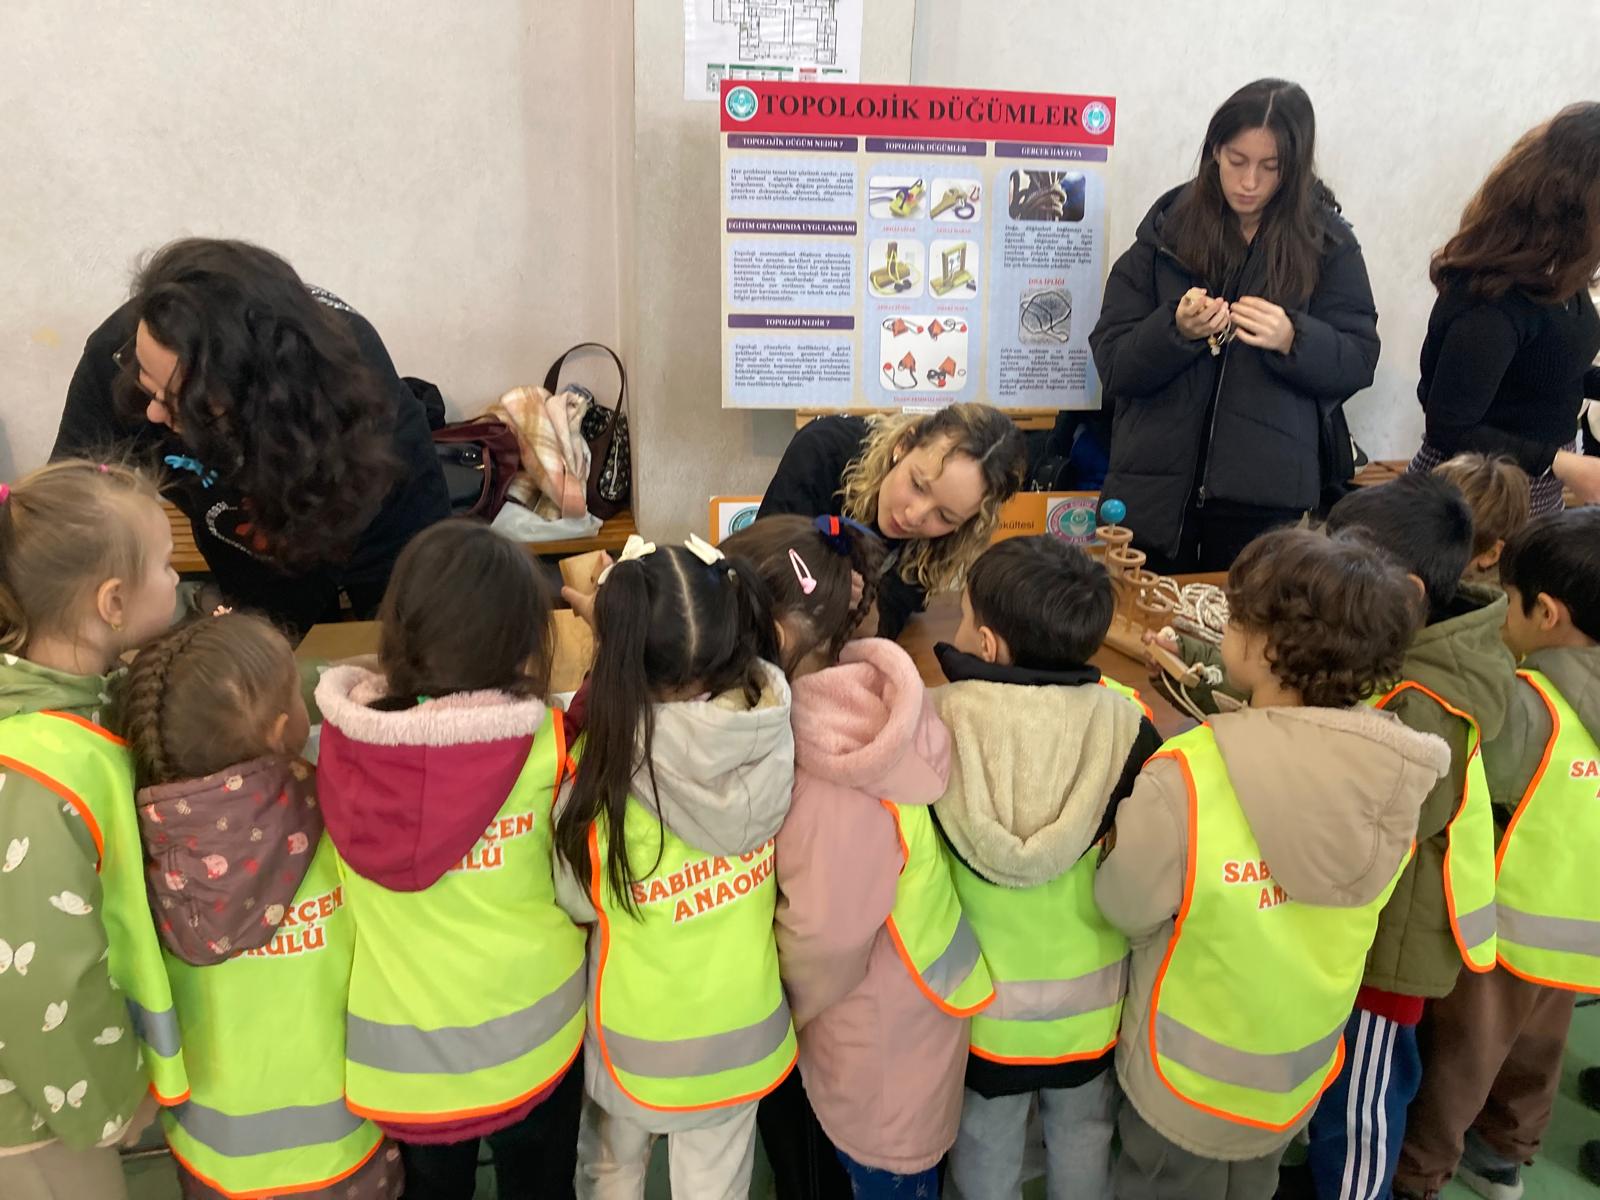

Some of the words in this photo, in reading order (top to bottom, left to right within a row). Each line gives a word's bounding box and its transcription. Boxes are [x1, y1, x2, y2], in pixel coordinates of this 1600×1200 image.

[762, 91, 920, 120] TOPOLOJİK
[929, 96, 1078, 126] DÜĞÜMLER
[743, 137, 784, 146] TOPOLOJİK
[786, 138, 813, 147] DÜĞÜM
[815, 138, 838, 148] NEDİR
[885, 142, 925, 151] TOPOLOJİK
[927, 143, 967, 153] DÜĞÜMLER
[728, 221, 755, 230] EĞİTİM
[756, 222, 801, 231] ORTAMINDA
[802, 223, 855, 232] UYGULANMASI
[765, 318, 800, 326] TOPOLOJİ
[802, 318, 824, 327] NEDİR
[451, 842, 502, 870] LÜ
[632, 855, 731, 904] SABİHA
[675, 854, 776, 922] ANAOKU
[1259, 885, 1288, 909] AN
[231, 924, 325, 959] ULÜ
